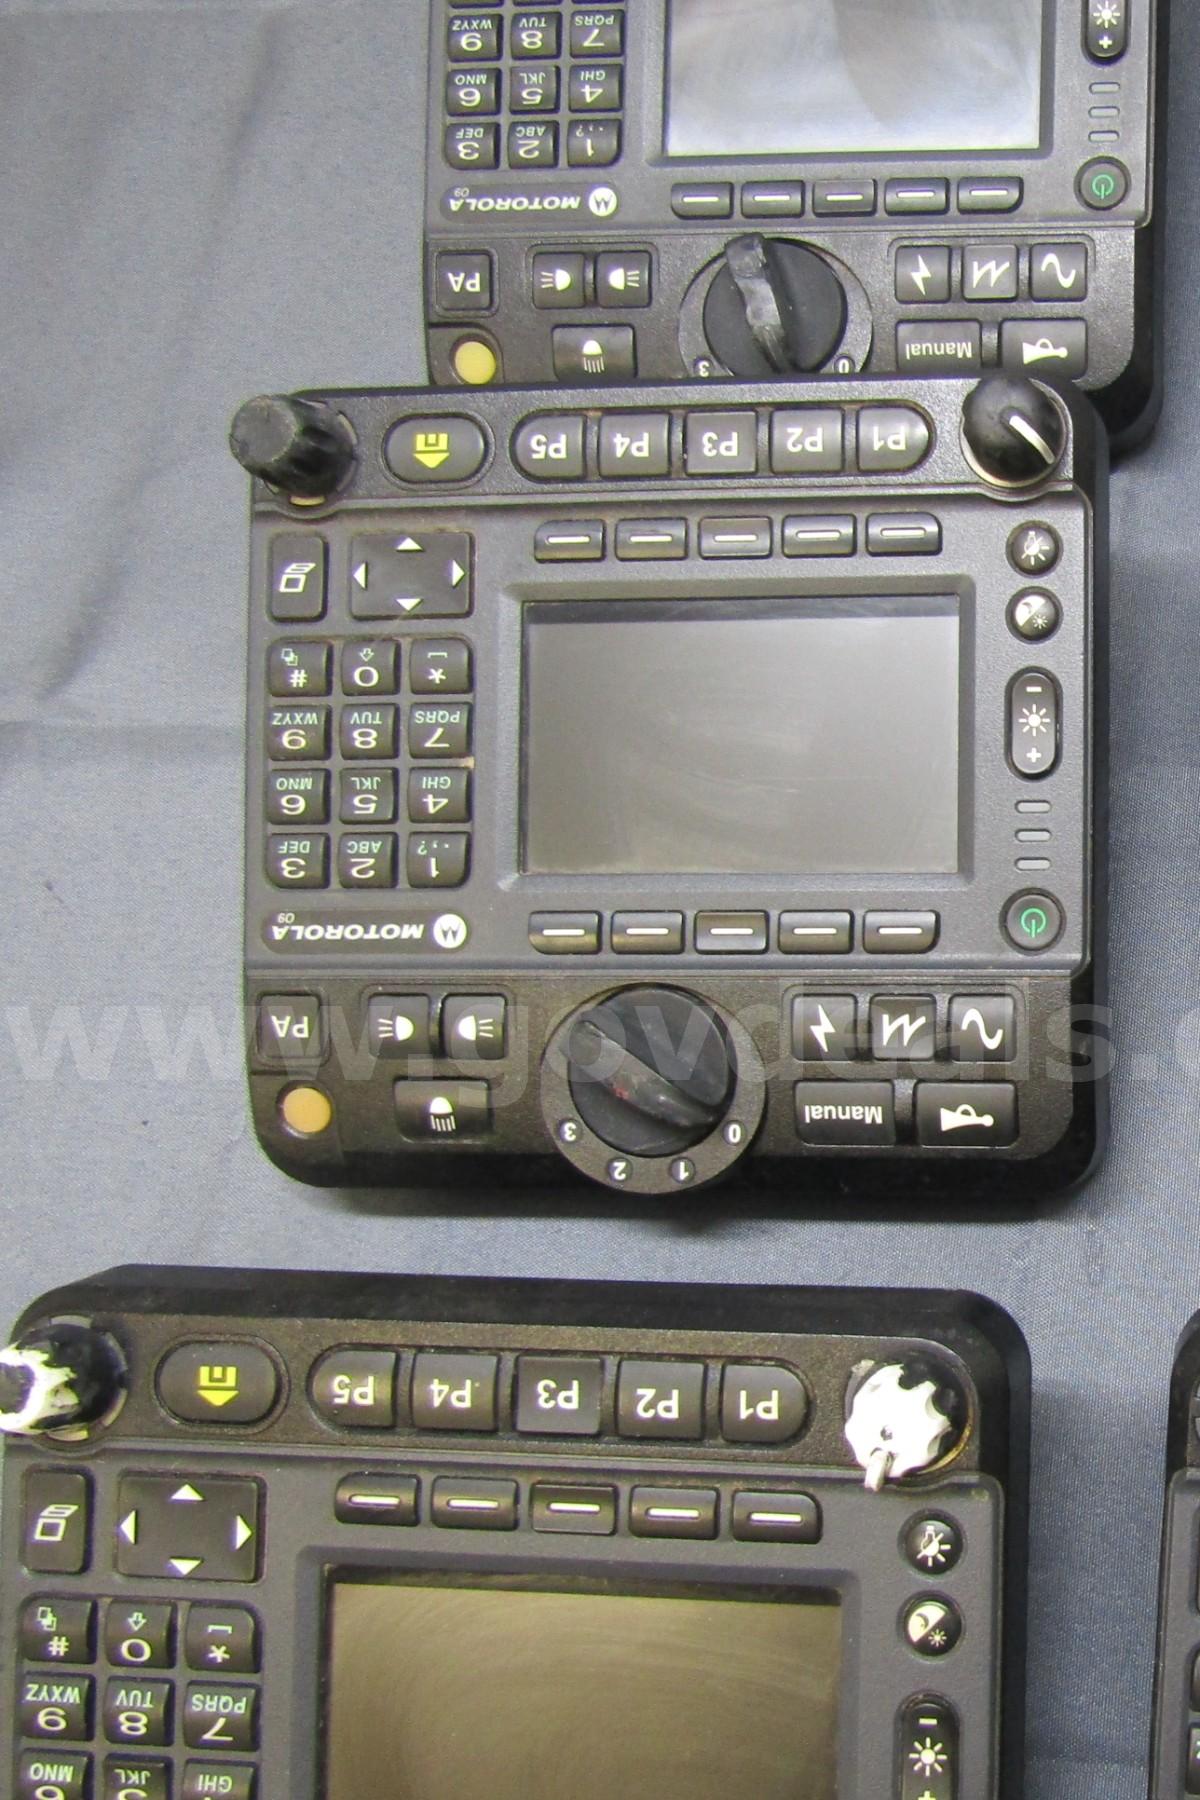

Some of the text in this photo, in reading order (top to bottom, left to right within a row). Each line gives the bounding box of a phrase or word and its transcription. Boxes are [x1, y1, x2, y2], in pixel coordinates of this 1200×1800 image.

[452, 19, 492, 31] WXYZ
[519, 17, 547, 28] TUV
[575, 15, 614, 26] PQRS
[460, 33, 483, 51] 9
[521, 31, 543, 49] 8
[583, 29, 604, 47] 7
[455, 74, 487, 85] MNO
[519, 72, 546, 84] JKL
[580, 70, 606, 81] GHI
[458, 88, 482, 106] 6
[521, 88, 543, 105] 5
[582, 85, 603, 103] 4
[455, 127, 484, 139] DEF
[515, 126, 545, 137] ABC
[458, 141, 480, 160] 3
[518, 140, 540, 158] 2
[586, 138, 594, 157] 1
[450, 196, 581, 211] MOTOROLA
[448, 272, 481, 292] PA
[905, 341, 972, 358] Manual
[699, 360, 709, 376] 3
[530, 433, 567, 458] P5
[613, 433, 650, 457] P4
[702, 430, 738, 456] P3
[786, 426, 823, 452] P2
[872, 425, 906, 450] P1
[272, 711, 318, 725] WXYZ
[350, 712, 381, 724] TUV
[414, 711, 460, 724] PQRS
[281, 729, 306, 749] 9
[353, 729, 377, 748] 8
[425, 729, 450, 748] 7
[276, 776, 313, 789] MNO
[351, 777, 381, 789] JKL
[422, 776, 451, 788] GHI
[281, 795, 306, 815] 6
[353, 795, 378, 814] 5
[423, 795, 449, 814] 4
[278, 841, 310, 853] DEF
[346, 841, 382, 853] ABC
[280, 858, 306, 878] 3
[350, 858, 375, 878] 2
[429, 858, 440, 877] 1
[272, 924, 424, 940] MOTOROLA
[271, 1015, 309, 1038] PA
[804, 1105, 883, 1124] Manual
[564, 1123, 577, 1141] 3
[728, 1124, 742, 1143] 0
[612, 1162, 627, 1180] 2
[679, 1162, 689, 1180] 1
[333, 1376, 375, 1406] P5
[430, 1379, 473, 1409] P4
[537, 1380, 580, 1410] P3
[636, 1388, 680, 1419] P2
[739, 1390, 780, 1420] P1
[26, 1684, 80, 1704] WXYZ
[115, 1690, 153, 1708] TUV
[191, 1694, 247, 1714] PQRS
[37, 1708, 67, 1731] 9
[118, 1712, 147, 1736] 8
[202, 1718, 233, 1741] 7
[29, 1763, 74, 1782] MNO
[114, 1769, 151, 1785] JKL
[197, 1774, 232, 1793] GHI
